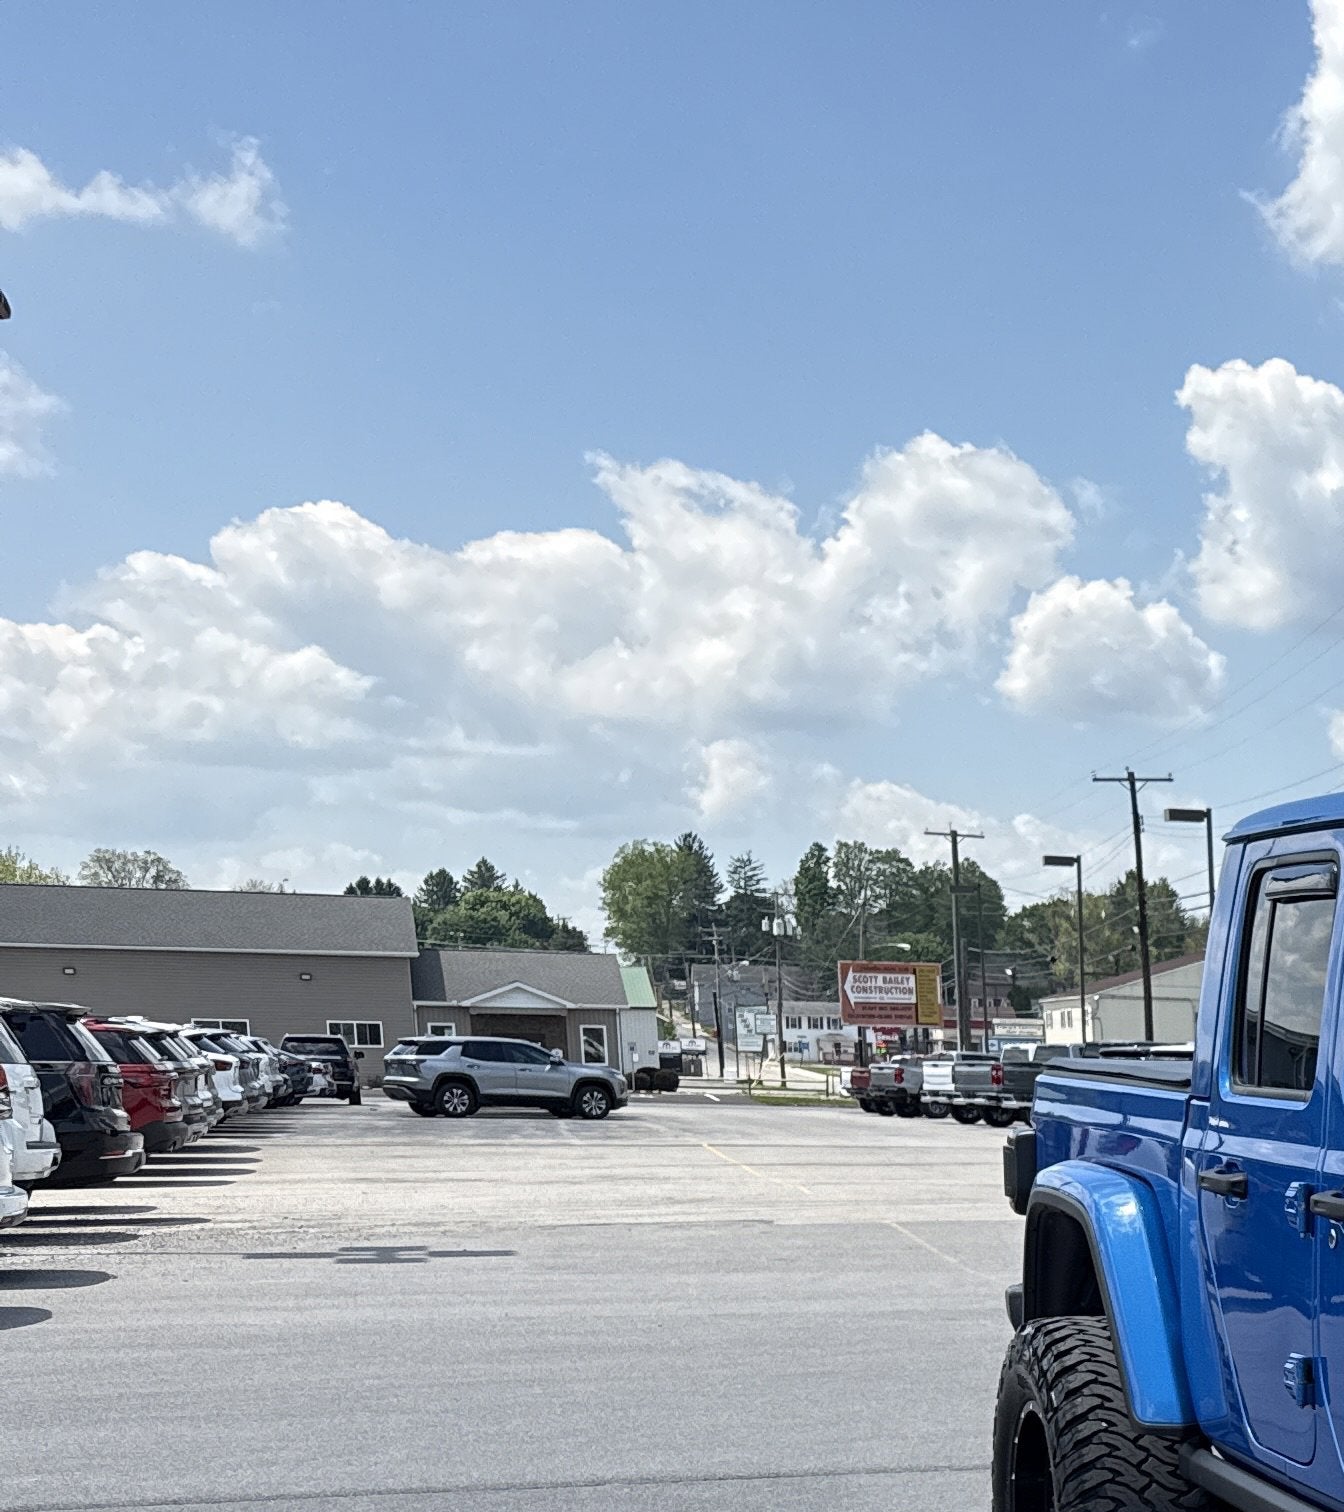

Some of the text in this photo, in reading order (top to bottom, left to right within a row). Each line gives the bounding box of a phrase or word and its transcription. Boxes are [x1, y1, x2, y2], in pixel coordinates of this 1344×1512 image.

[852, 974, 911, 986] SCOTT BAILEY
[850, 985, 914, 997] CONSTRUCTION
